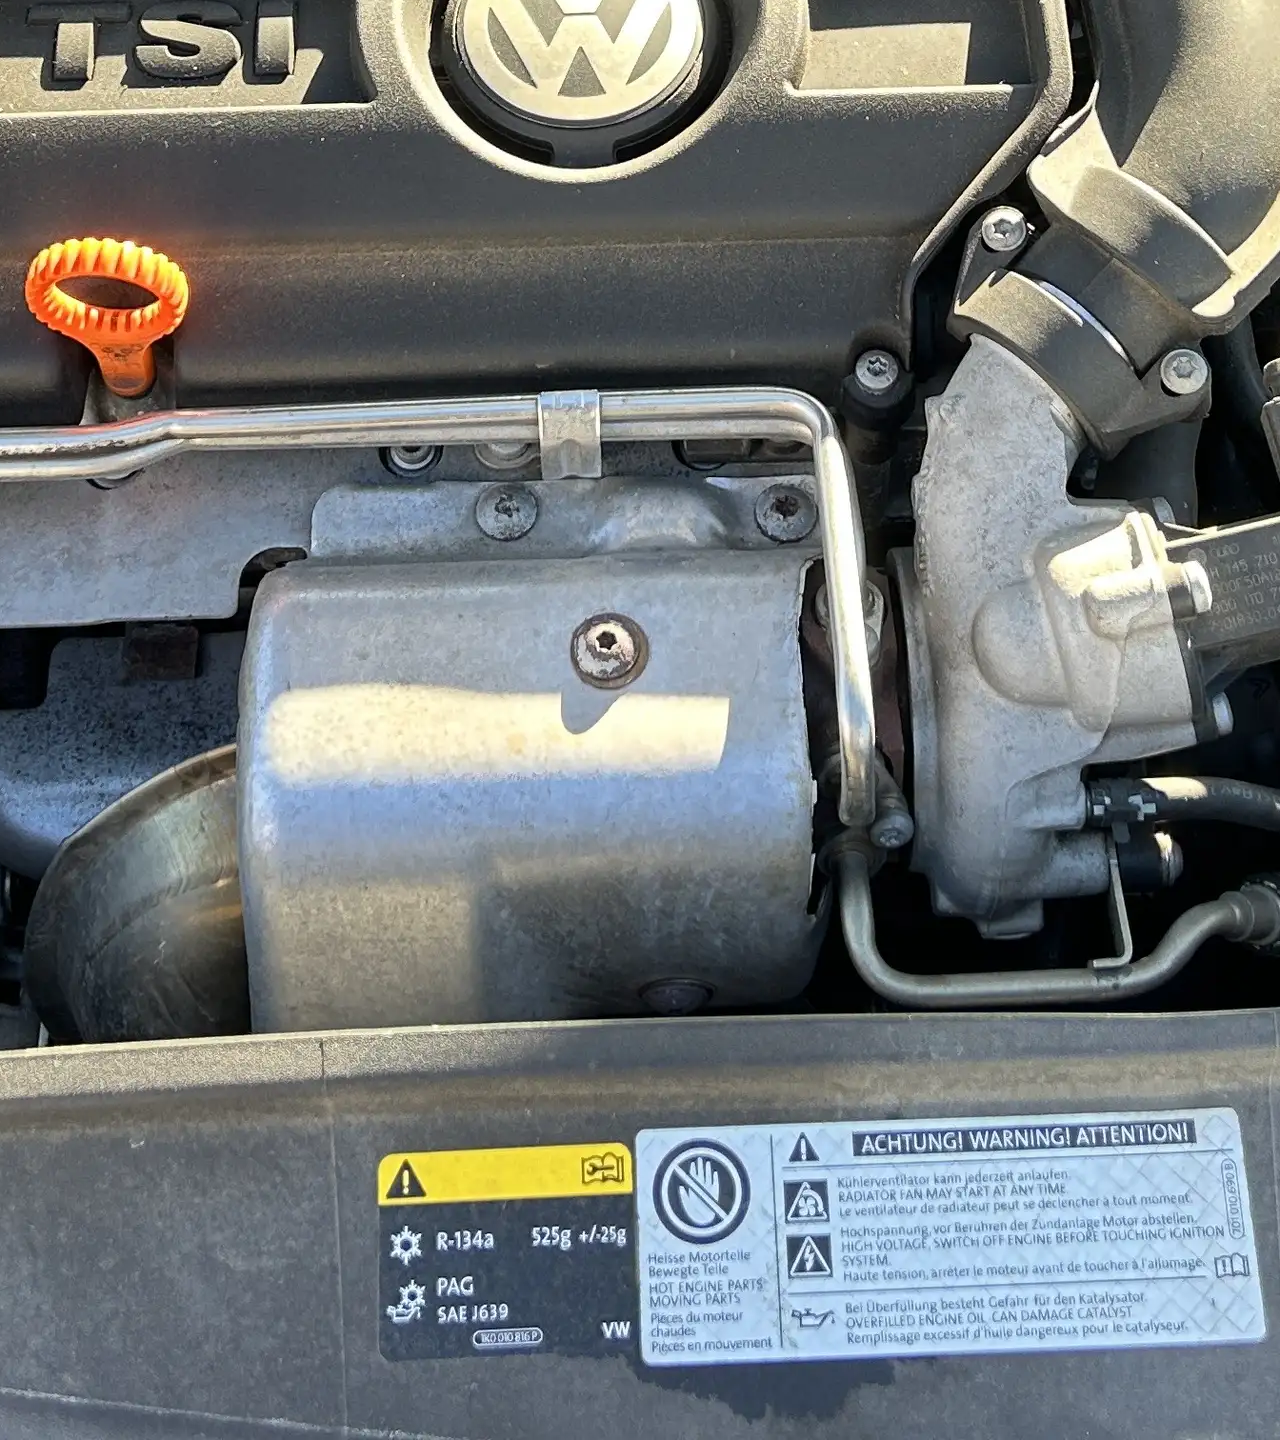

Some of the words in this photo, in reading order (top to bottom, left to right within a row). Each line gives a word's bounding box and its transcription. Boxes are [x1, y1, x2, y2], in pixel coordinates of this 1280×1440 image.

[862, 1130, 963, 1153] ACHTUNG!
[970, 1126, 1071, 1149] WARNING!
[1076, 1122, 1189, 1146] ATTENTION!
[837, 1175, 930, 1189] Kühlerventilator
[934, 1171, 961, 1184] kann
[965, 1170, 1014, 1186] jederzeit
[838, 1188, 897, 1202] RADIATOR
[900, 1188, 923, 1201] FAN
[926, 1187, 953, 1200] MAY
[956, 1185, 990, 1198] START
[993, 1184, 1007, 1197] AT
[1010, 1184, 1034, 1196] ANY
[839, 1206, 852, 1217] Le
[855, 1203, 916, 1216] ventilateur
[920, 1202, 934, 1214] de
[938, 1200, 990, 1213] radiateur
[993, 1200, 1020, 1216] peut
[1023, 1200, 1035, 1210] se
[1113, 1195, 1137, 1207] tout
[934, 1225, 951, 1235] vor
[1010, 1219, 1028, 1231] der
[1103, 1216, 1138, 1227] Motor
[436, 1229, 495, 1251] R-134a
[531, 1225, 572, 1251] 525g
[579, 1224, 627, 1247] +/-25g
[841, 1240, 873, 1252] HIGH
[934, 1236, 980, 1249] SWITCH
[982, 1234, 1004, 1247] OFF
[1007, 1233, 1052, 1246] ENGINE
[1055, 1231, 1100, 1244] BEFORE
[1103, 1229, 1167, 1241] TOUCHING
[1170, 1225, 1225, 1239] IGNITION
[648, 1252, 686, 1265] Heisse
[689, 1250, 751, 1263] Motorteile
[842, 1255, 892, 1267] SYSTEM.
[648, 1264, 700, 1279] Bewegte
[703, 1263, 729, 1276] Teile
[843, 1268, 878, 1281] Haute
[973, 1264, 983, 1276] le
[986, 1262, 1029, 1275] moteur
[1031, 1262, 1064, 1274] avant
[1067, 1260, 1081, 1272] de
[1084, 1259, 1128, 1272] toucher
[436, 1275, 474, 1298] PAG
[649, 1281, 674, 1295] HOT
[678, 1280, 724, 1293] ENGINE
[728, 1277, 764, 1291] PARTS
[649, 1294, 702, 1308] MOVING
[705, 1292, 741, 1305] PARTS
[845, 1302, 863, 1314] Bei
[941, 1297, 985, 1310] besteht
[988, 1295, 1028, 1309] Gefahr
[1054, 1294, 1076, 1306] den
[436, 1305, 468, 1324] SAE
[472, 1302, 509, 1323] J639
[686, 1310, 701, 1323] du
[703, 1310, 744, 1322] moteur
[845, 1315, 916, 1330] OVERFILLED
[920, 1313, 964, 1326] ENGINE
[967, 1311, 985, 1324] OIL
[992, 1310, 1018, 1323] CAN
[1020, 1308, 1074, 1321] DAMAGE
[531, 1330, 538, 1341] P
[602, 1321, 631, 1340] VW
[651, 1325, 697, 1338] chaudes
[847, 1330, 921, 1347] Remplissage
[924, 1328, 970, 1341] excessif
[1016, 1324, 1079, 1339] dangereux
[1082, 1322, 1108, 1337] pour
[1112, 1321, 1123, 1333] le
[688, 1341, 702, 1351] en
[704, 1336, 773, 1351] mouvement
